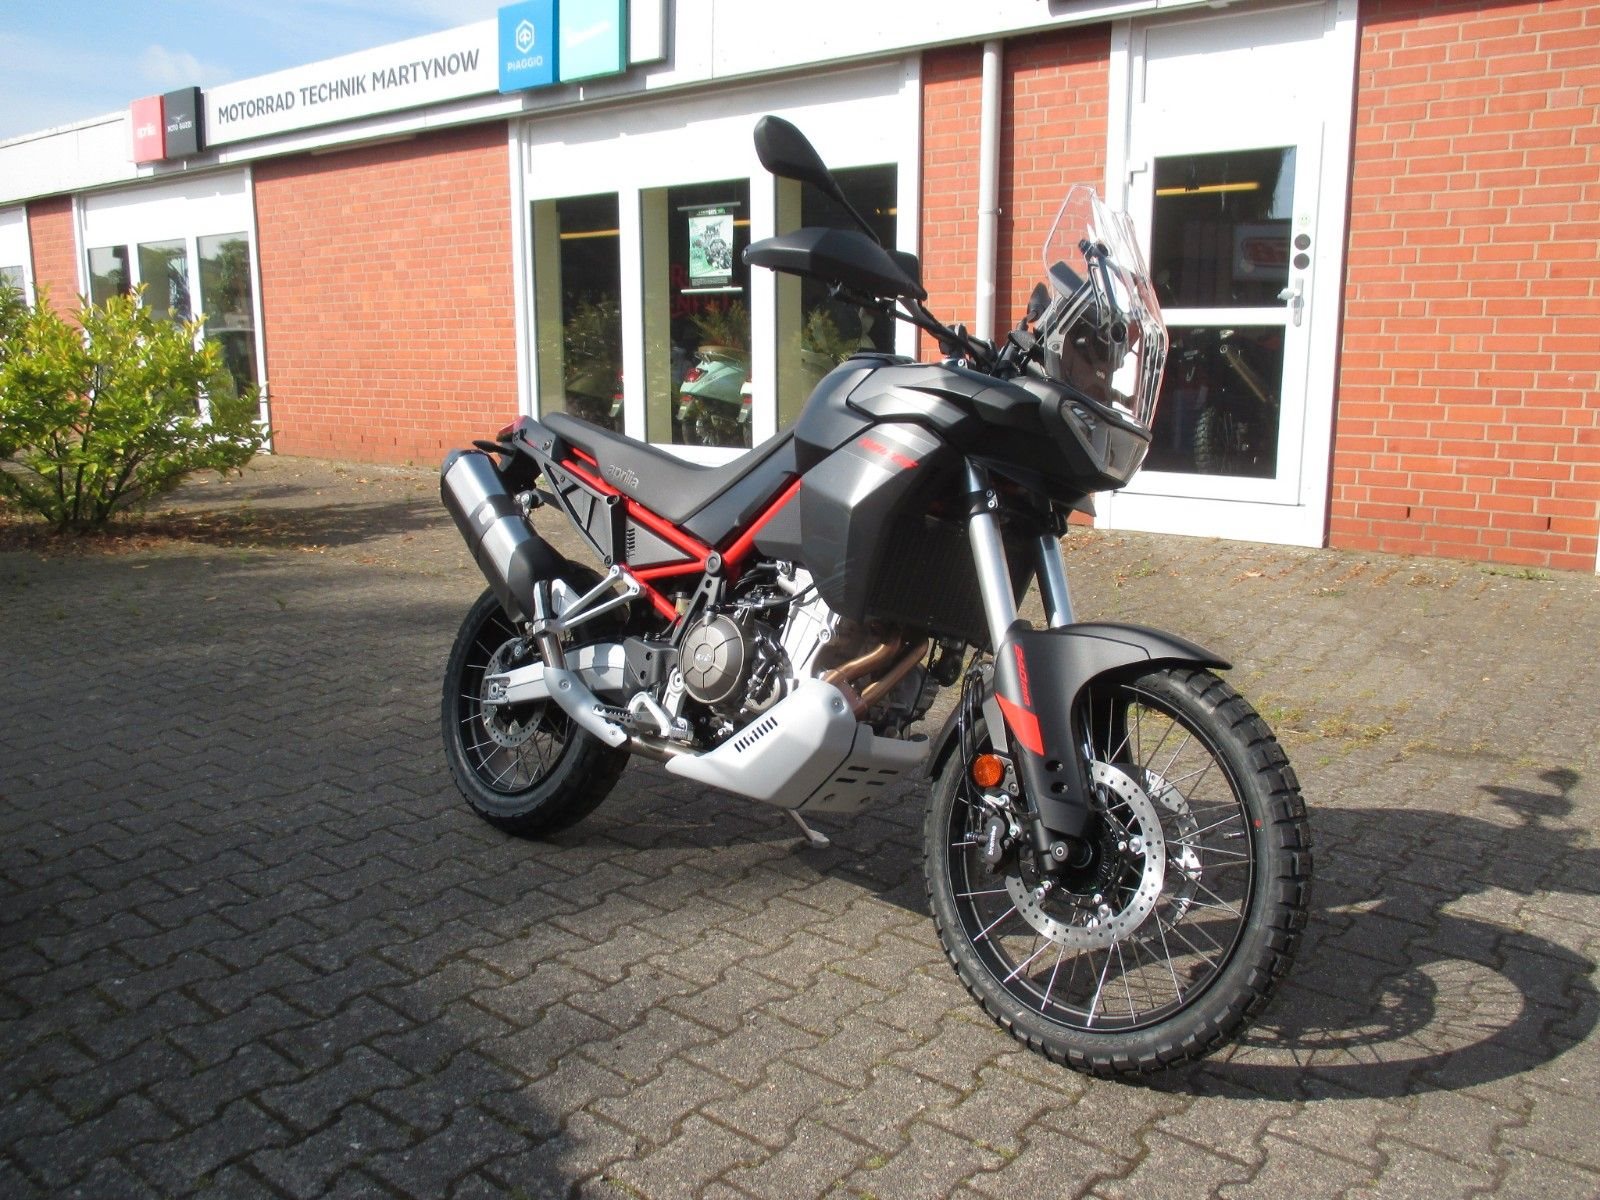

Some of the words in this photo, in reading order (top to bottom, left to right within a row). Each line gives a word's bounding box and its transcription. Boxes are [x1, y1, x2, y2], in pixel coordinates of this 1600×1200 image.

[507, 56, 543, 72] PIAGGIO
[218, 91, 295, 125] MOTORRAD
[300, 74, 367, 106] TECHNIK
[372, 48, 480, 91] MARTYNOW
[607, 463, 639, 489] aprilia
[988, 825, 997, 856] brembo
